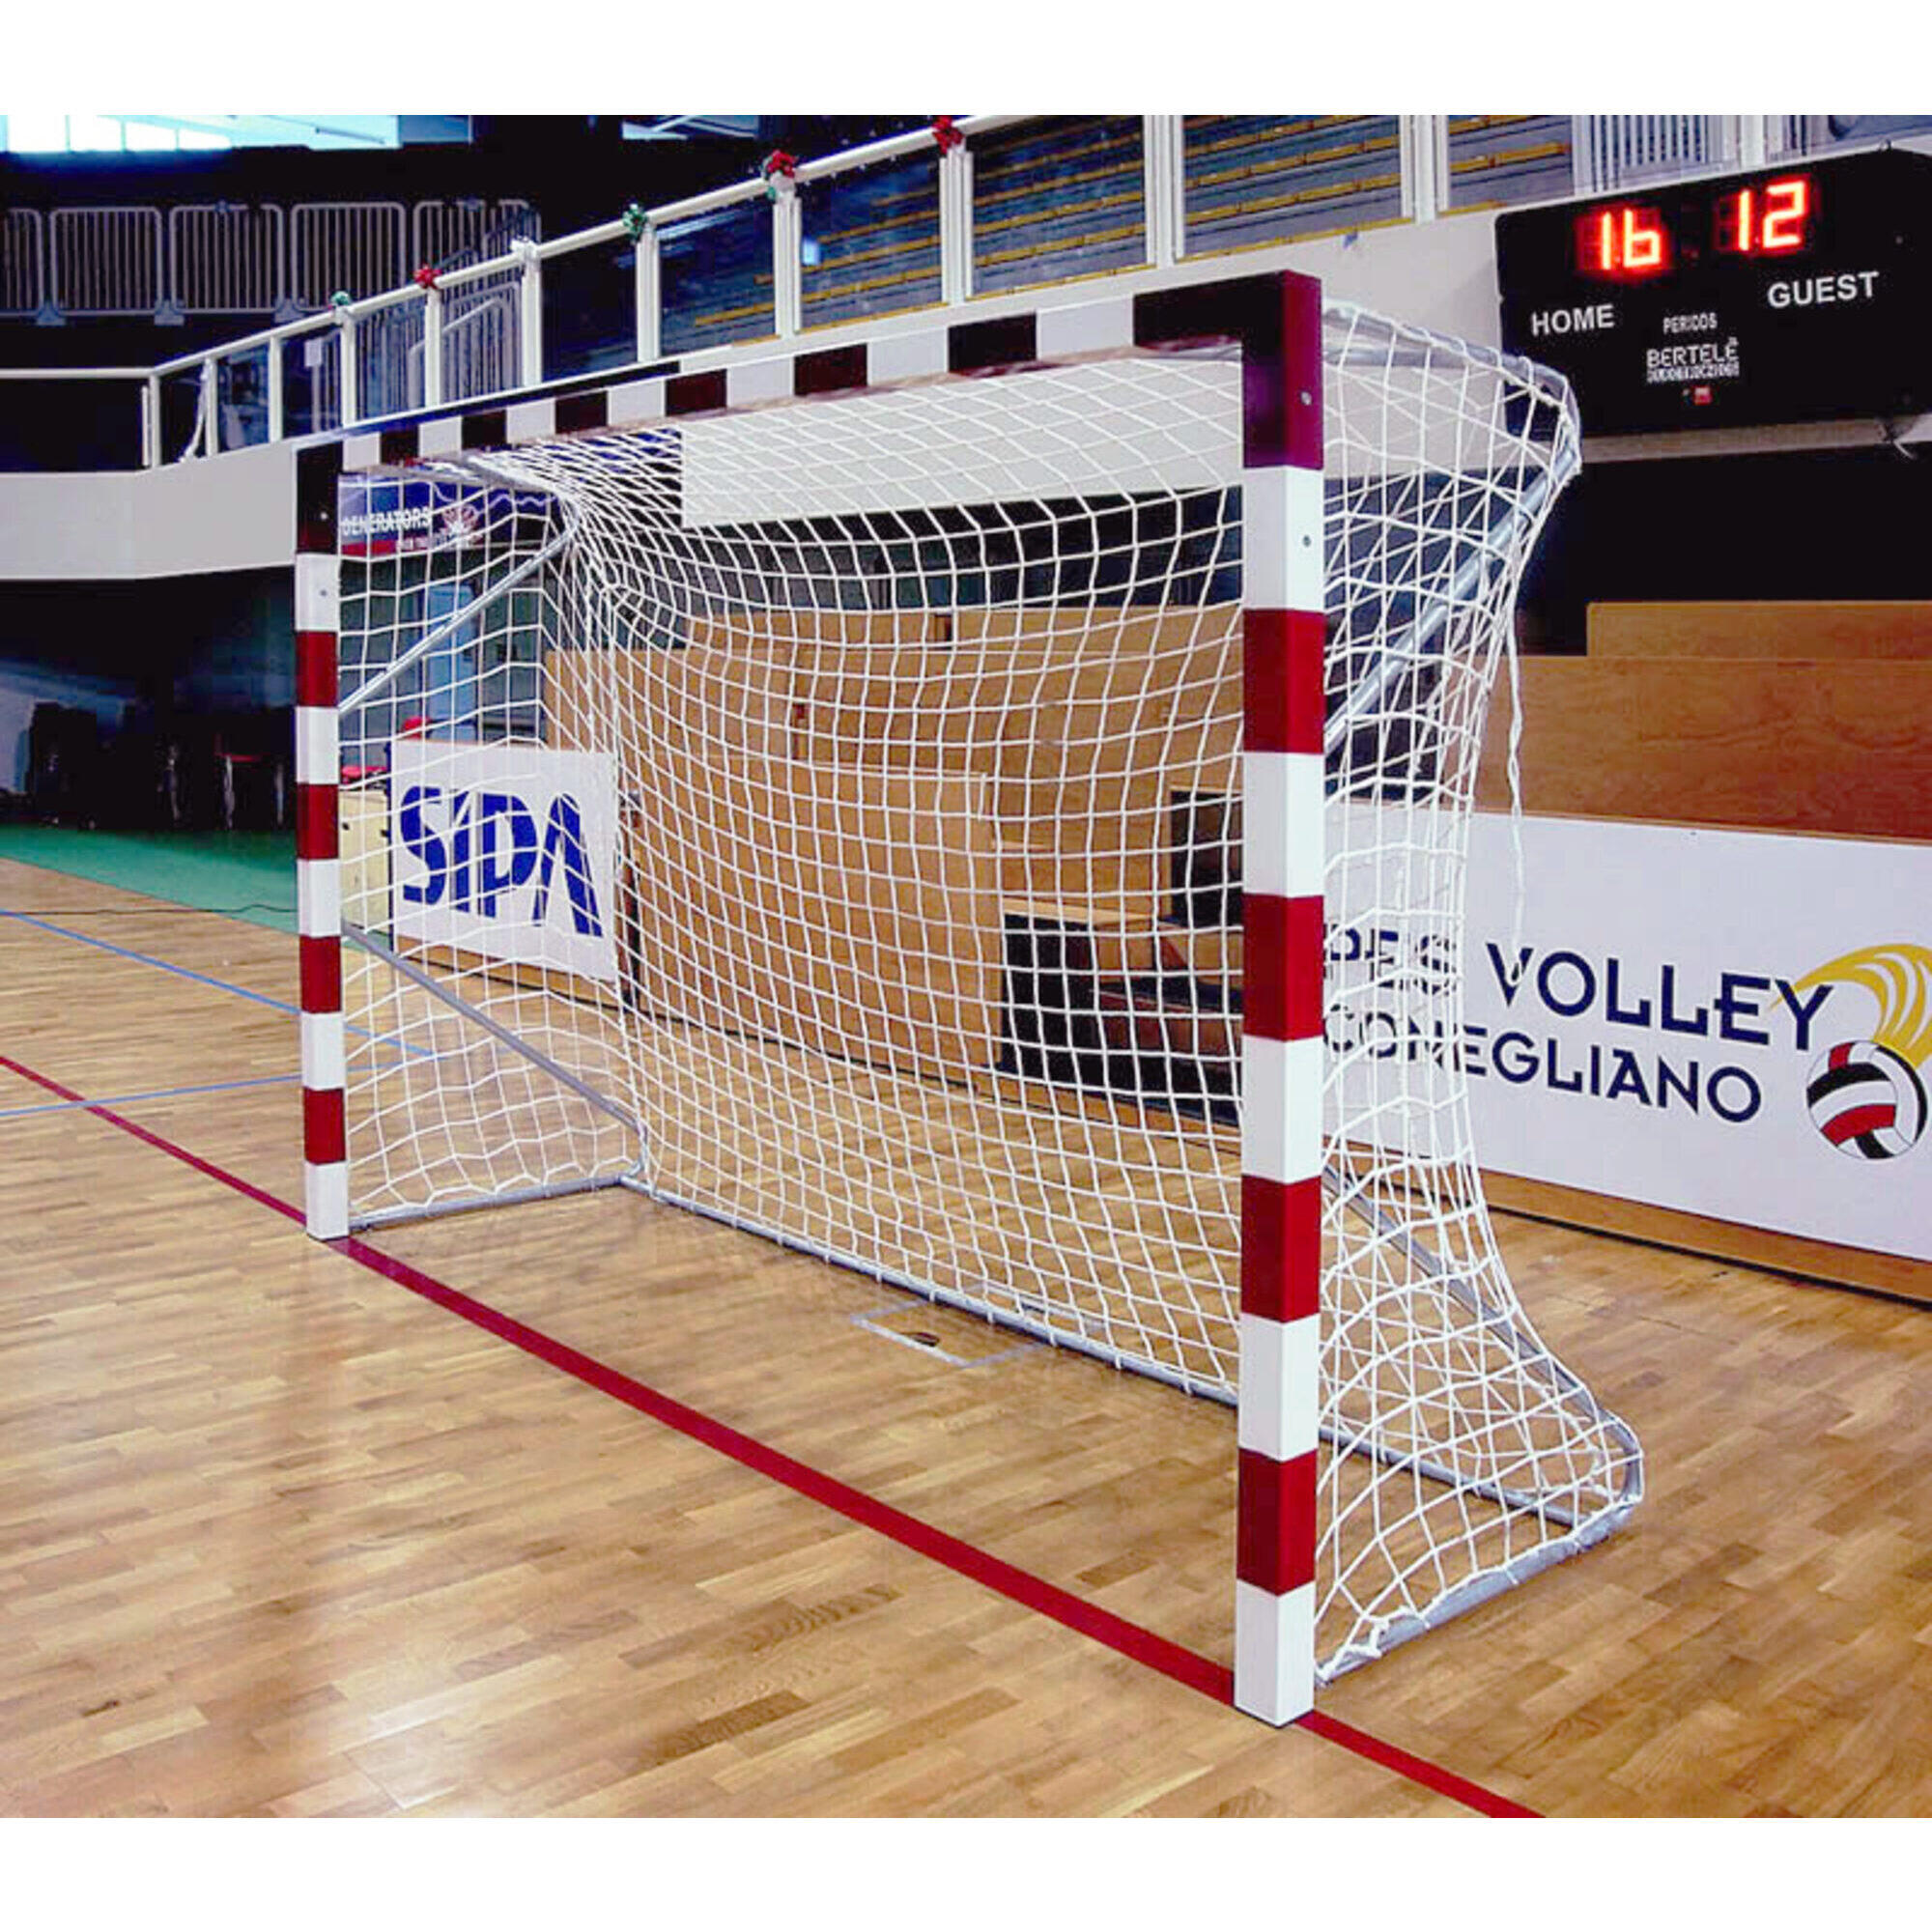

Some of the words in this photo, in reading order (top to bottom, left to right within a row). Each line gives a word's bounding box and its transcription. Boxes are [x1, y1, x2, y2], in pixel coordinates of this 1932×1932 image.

[1601, 209, 1662, 270] 16
[1738, 180, 1807, 252] 12
[1531, 304, 1616, 337] HOME
[1768, 270, 1880, 309] GUEST
[400, 785, 604, 939] SIPA
[1486, 942, 1834, 1052] VOLLEY
[1323, 1004, 1762, 1123] CONEGLIANO
